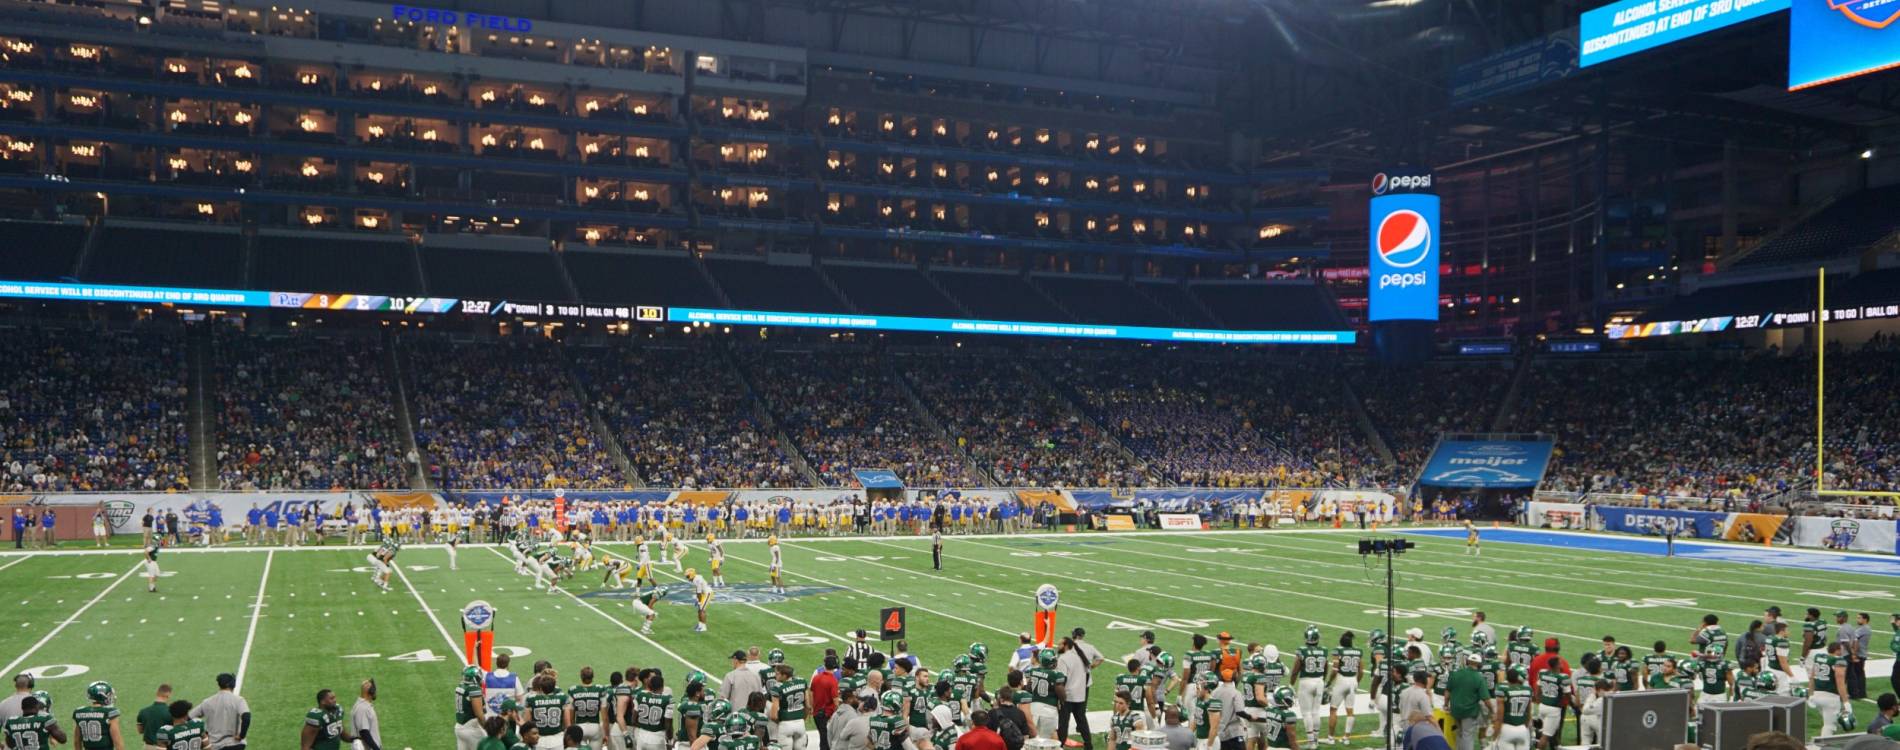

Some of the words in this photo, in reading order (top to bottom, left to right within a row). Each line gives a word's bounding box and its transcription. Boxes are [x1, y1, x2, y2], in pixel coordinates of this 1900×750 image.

[392, 5, 457, 26] FORD
[467, 13, 532, 32] FIELD
[1613, 1, 1656, 27] ALCOHOL
[1582, 21, 1656, 55] DISCONTINUED
[1656, 16, 1671, 33] AT
[1670, 9, 1693, 29] END
[1693, 4, 1708, 22] OF
[1709, 0, 1732, 17] 3RD
[1389, 175, 1430, 191] pepsi
[1379, 271, 1426, 289] pepsi
[60, 287, 81, 296] WILL
[319, 295, 329, 307] 3
[389, 298, 404, 310] 10
[462, 300, 490, 313] 12:27
[642, 308, 657, 319] 10
[1734, 315, 1759, 329] 12:27
[1449, 456, 1528, 467] meijer
[884, 610, 902, 632] 4
[1305, 656, 1326, 673] 63
[575, 699, 600, 718] 35
[786, 692, 805, 713] 12
[1509, 696, 1530, 717] 17
[533, 706, 562, 728] 58
[637, 703, 663, 726] 20
[11, 730, 41, 750] 13
[79, 720, 103, 743] 10
